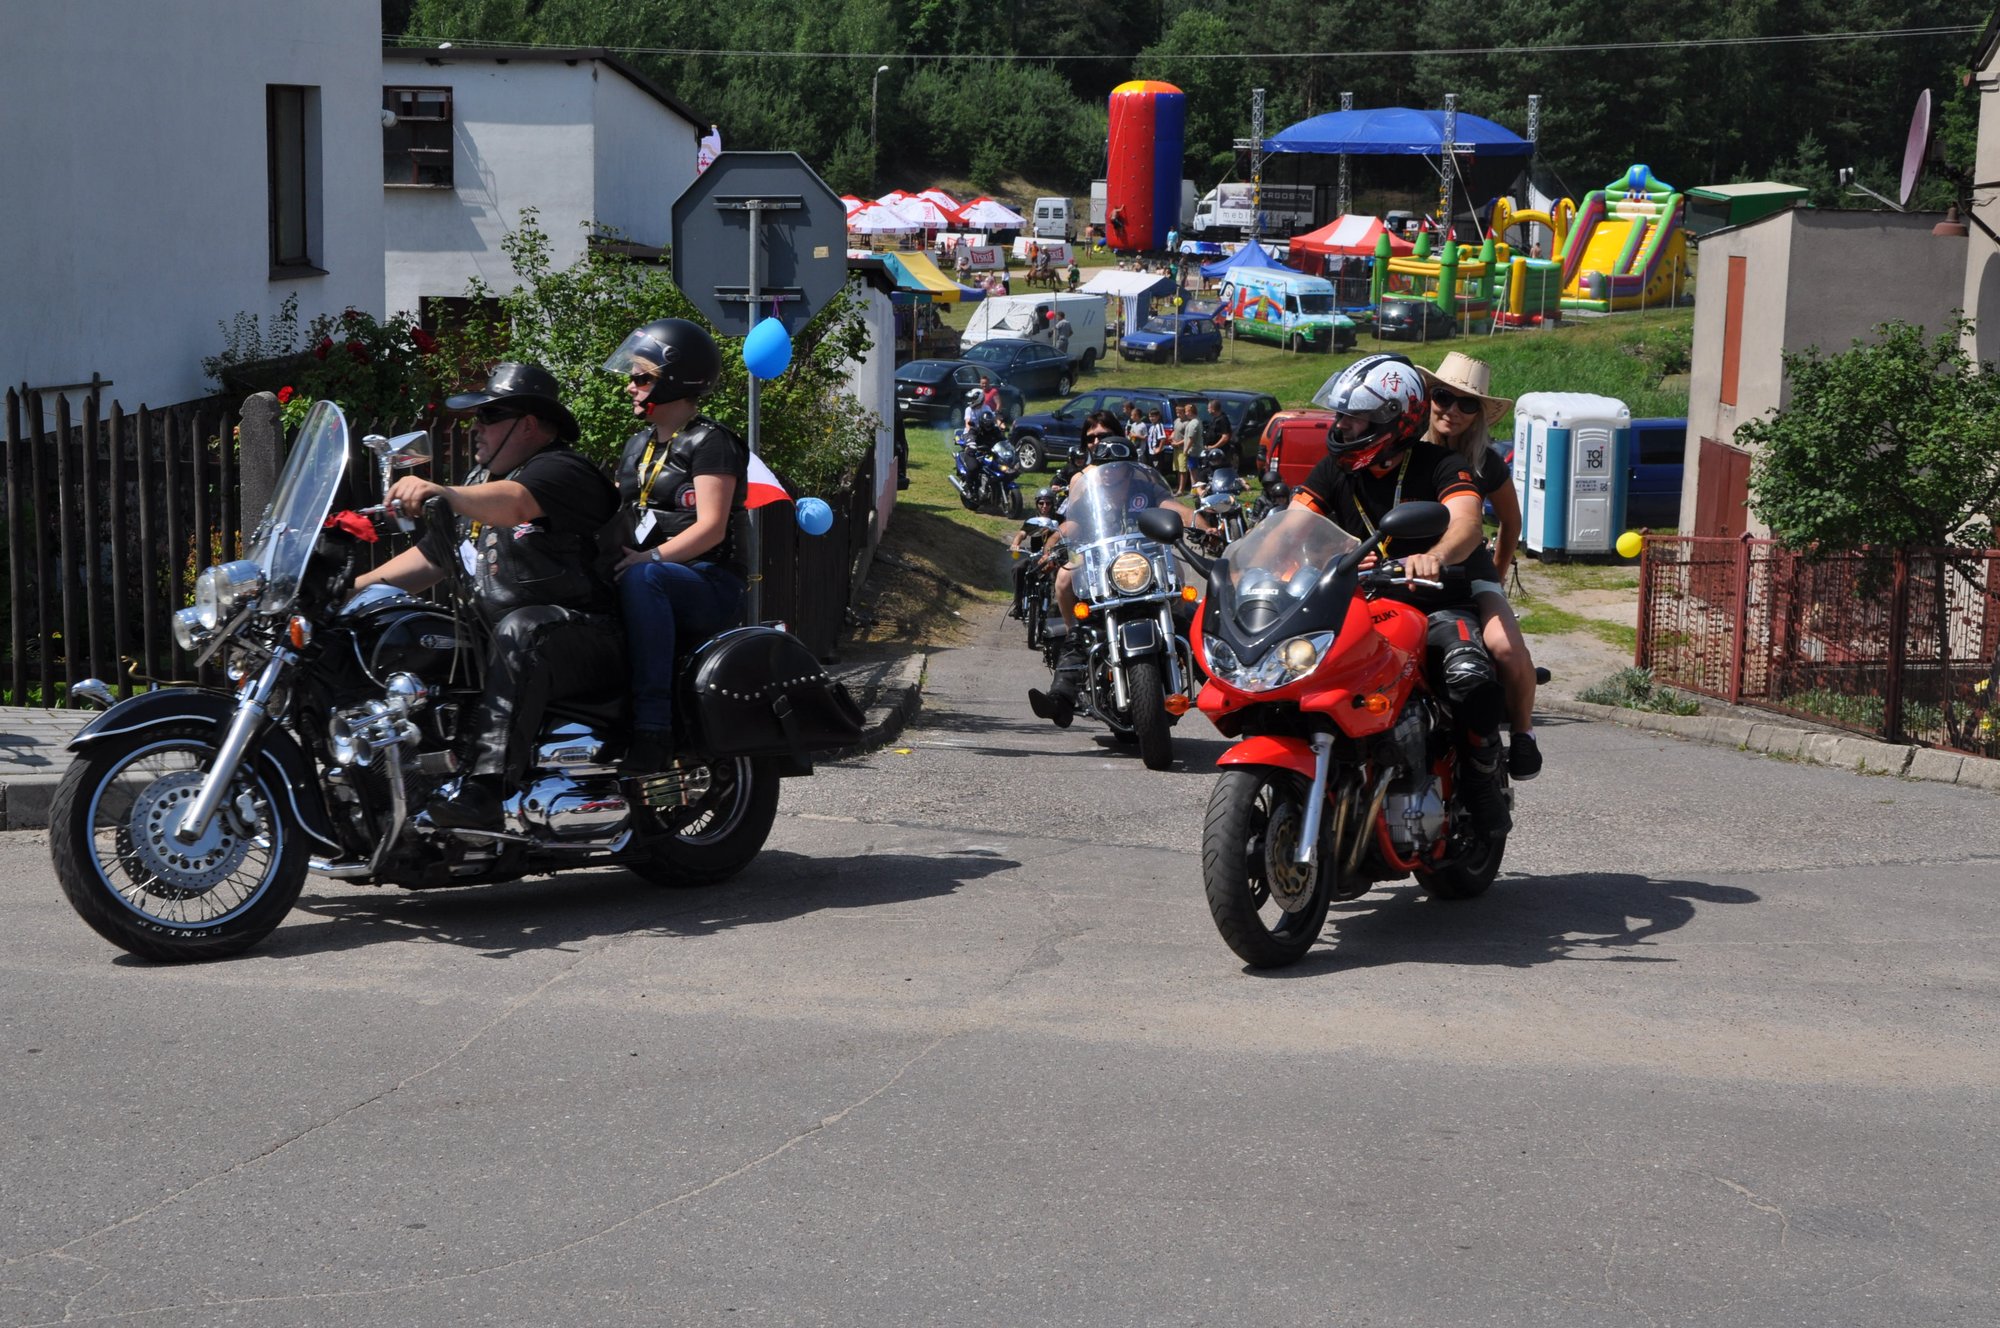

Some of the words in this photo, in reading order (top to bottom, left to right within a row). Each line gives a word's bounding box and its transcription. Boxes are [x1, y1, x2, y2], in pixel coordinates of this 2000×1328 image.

[972, 251, 995, 264] TYSKIE
[1381, 372, 1403, 392] 侍
[1587, 447, 1604, 459] TOI
[1587, 459, 1603, 468] TOI
[1371, 610, 1399, 624] ZUKI
